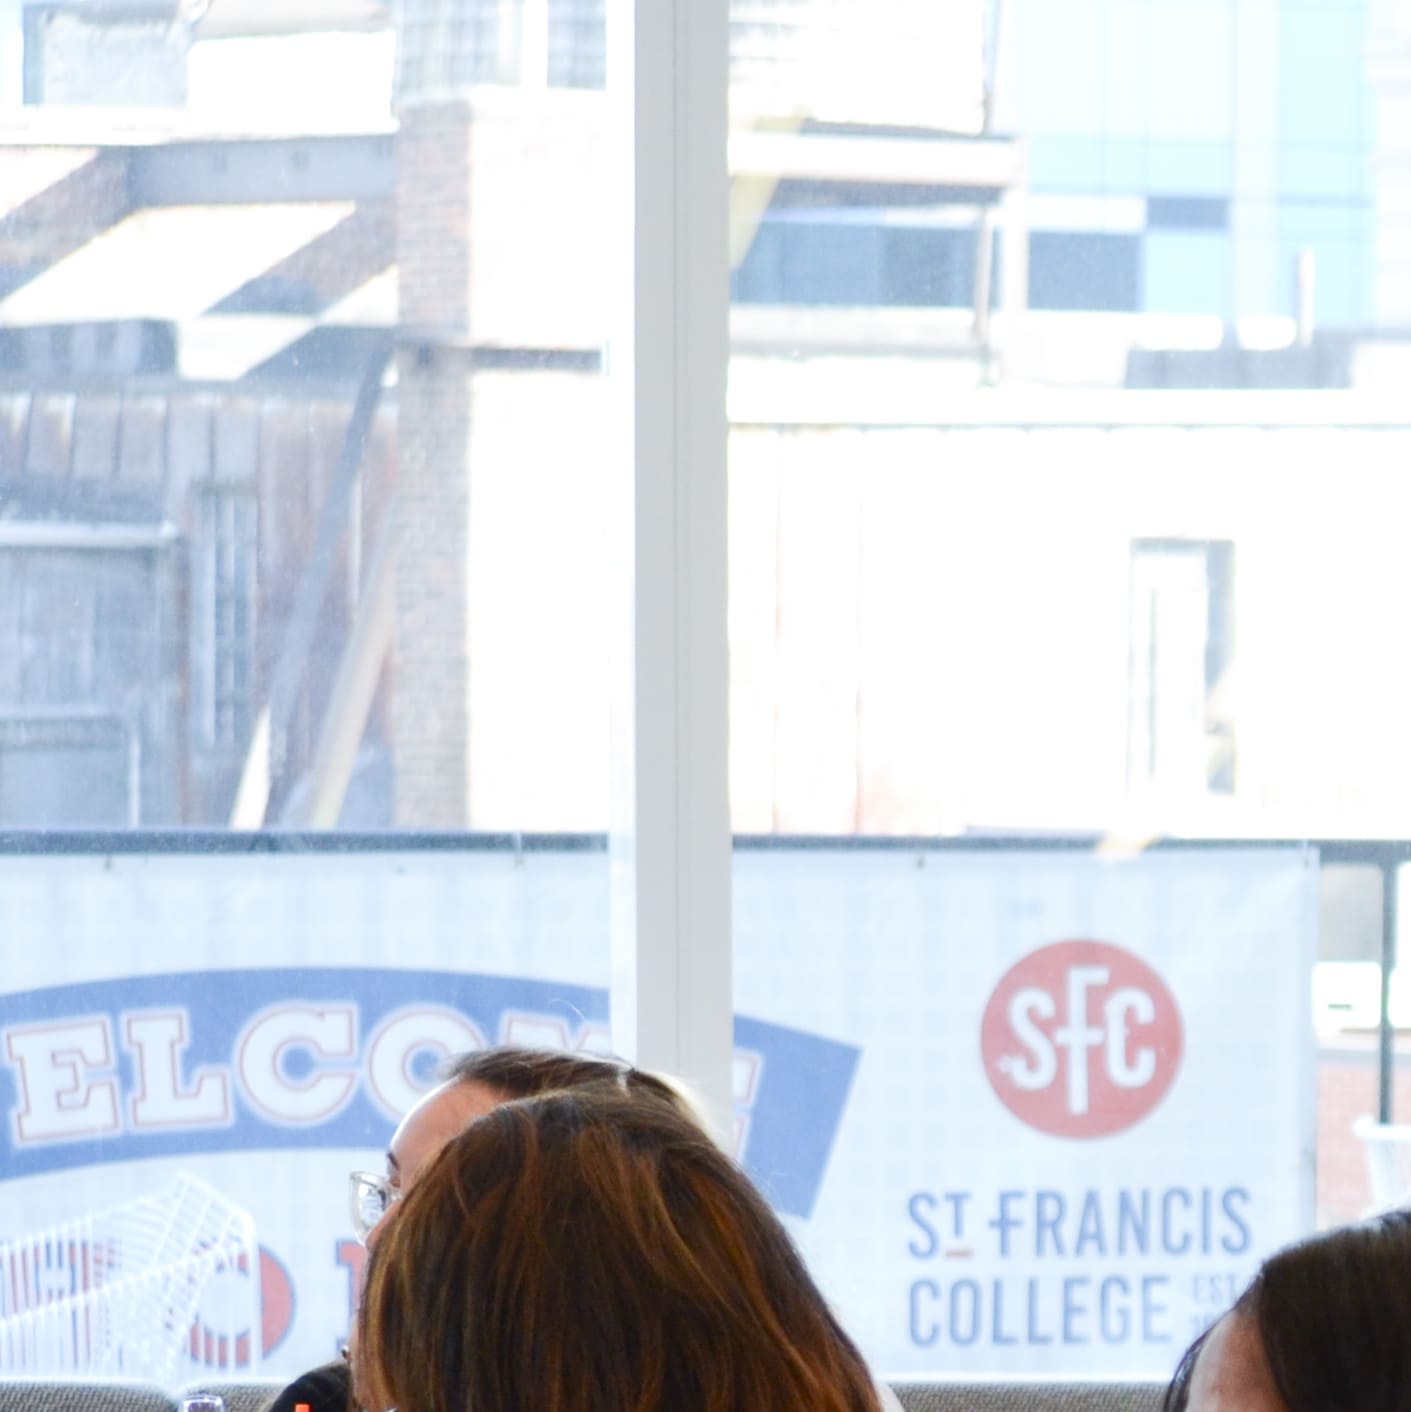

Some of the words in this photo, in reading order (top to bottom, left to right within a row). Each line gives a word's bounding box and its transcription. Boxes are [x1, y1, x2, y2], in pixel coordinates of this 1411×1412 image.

[5, 1000, 762, 1152] ELCO
[988, 1186, 1252, 1256] FRANCIS
[909, 1276, 1171, 1348] COLLEGE
